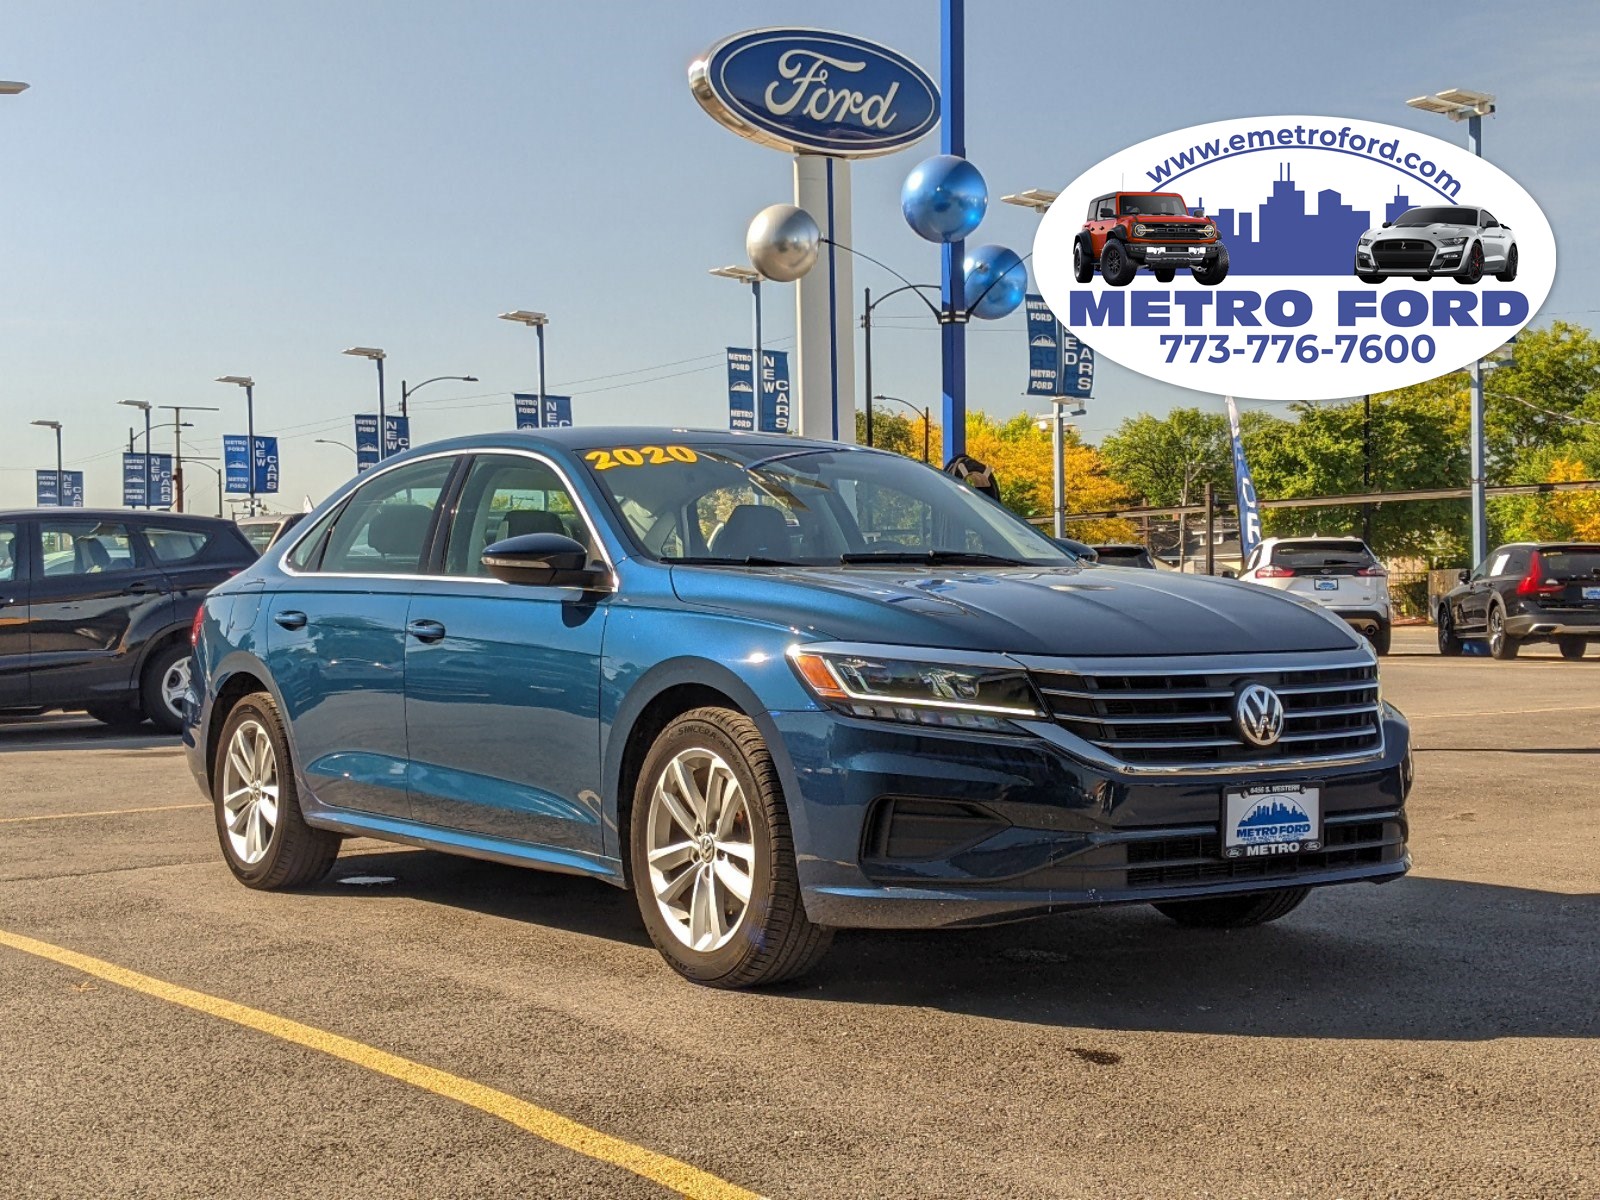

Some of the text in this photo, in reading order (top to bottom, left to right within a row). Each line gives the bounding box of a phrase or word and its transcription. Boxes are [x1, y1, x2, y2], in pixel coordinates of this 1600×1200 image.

[764, 49, 900, 129] Ford
[1027, 300, 1050, 310] METR
[1030, 312, 1053, 323] FORD
[728, 353, 752, 362] METRO
[731, 362, 751, 371] FORD
[1077, 340, 1093, 391] ARS
[763, 355, 775, 394] NEW
[1030, 368, 1057, 379] METRO
[1031, 380, 1054, 391] FORD
[730, 409, 754, 419] METRO
[775, 380, 789, 429] CARS
[732, 419, 752, 428] FORD
[386, 421, 398, 450] NEW
[255, 440, 266, 467] NEW
[584, 445, 699, 471] 2020
[150, 457, 160, 482] NEW
[266, 455, 278, 490] CARS
[160, 470, 171, 502] CARS
[1236, 826, 1278, 838] METRO
[1279, 823, 1311, 834] FORD
[1246, 842, 1300, 857] METRO
